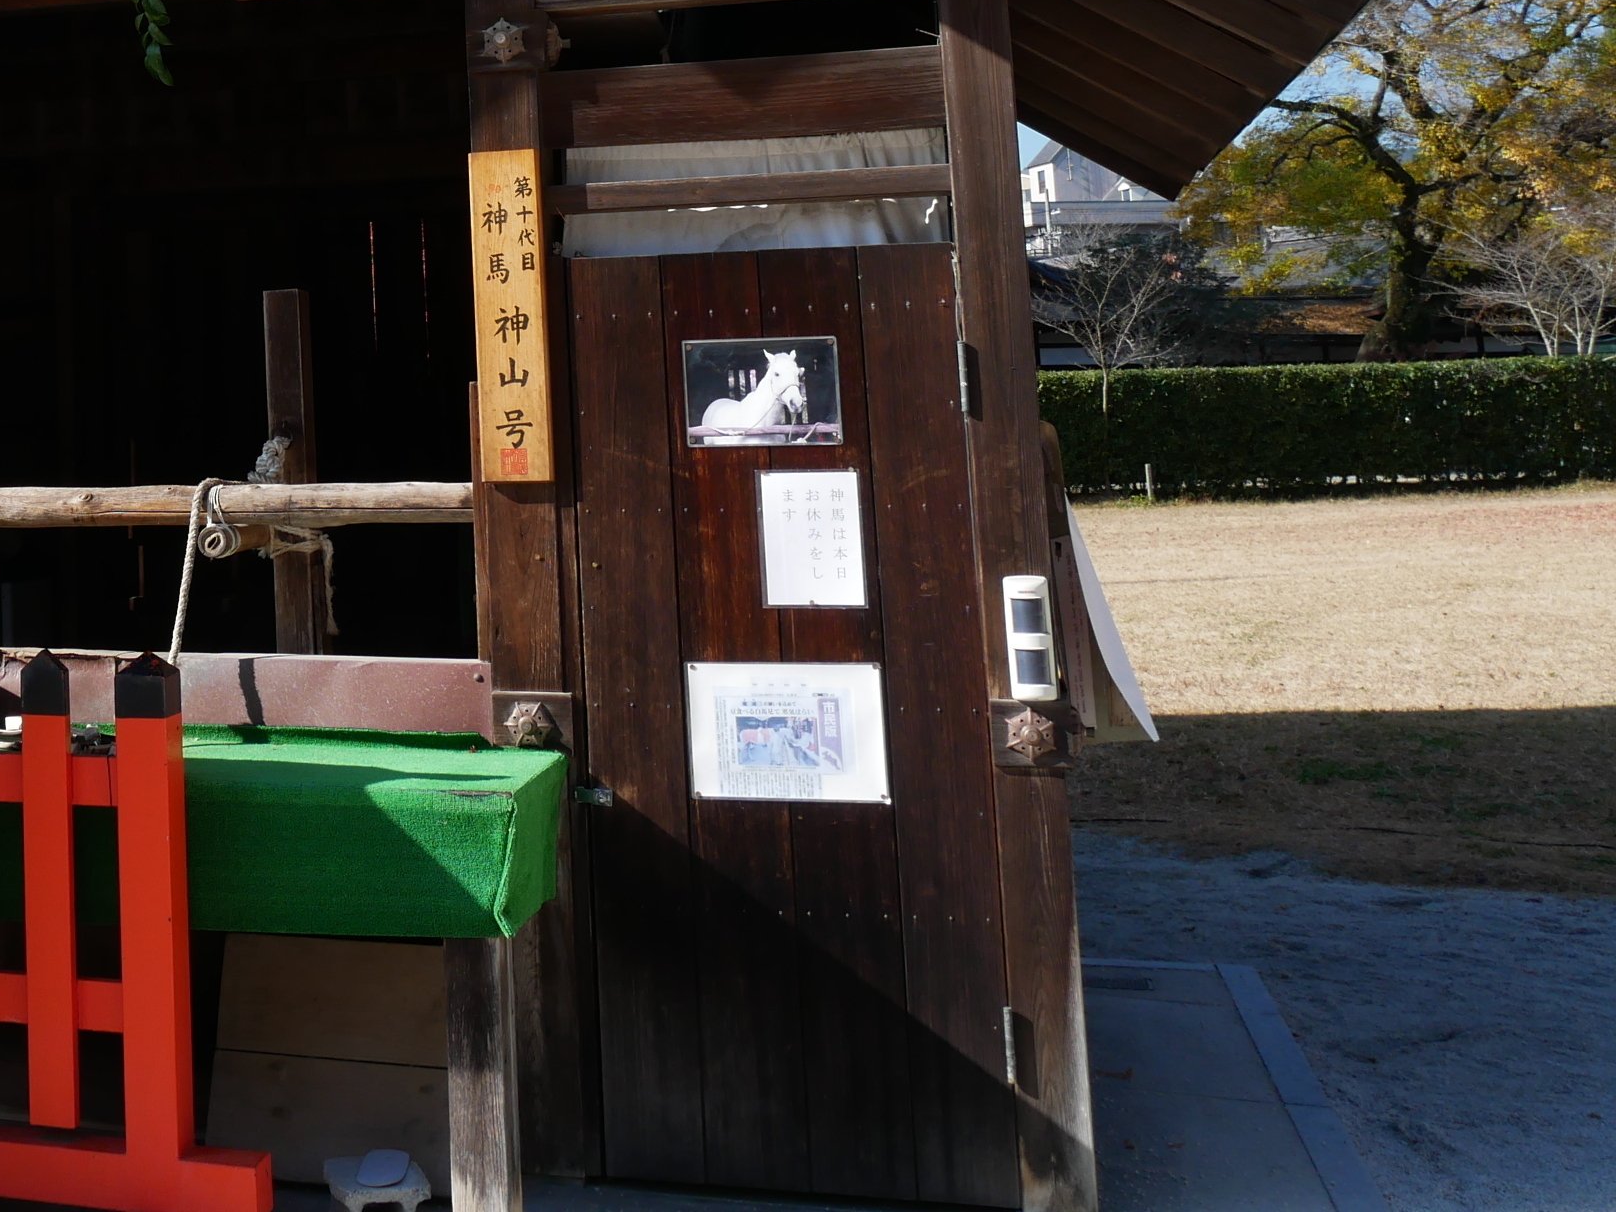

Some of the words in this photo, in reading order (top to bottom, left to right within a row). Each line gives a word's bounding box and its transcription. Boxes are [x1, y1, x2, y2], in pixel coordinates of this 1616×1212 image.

[513, 176, 536, 271] 第十代目
[481, 201, 534, 448] 神馬神山号
[781, 489, 797, 523] ます
[805, 488, 824, 580] お休みをし
[830, 488, 848, 580] 神馬は本日
